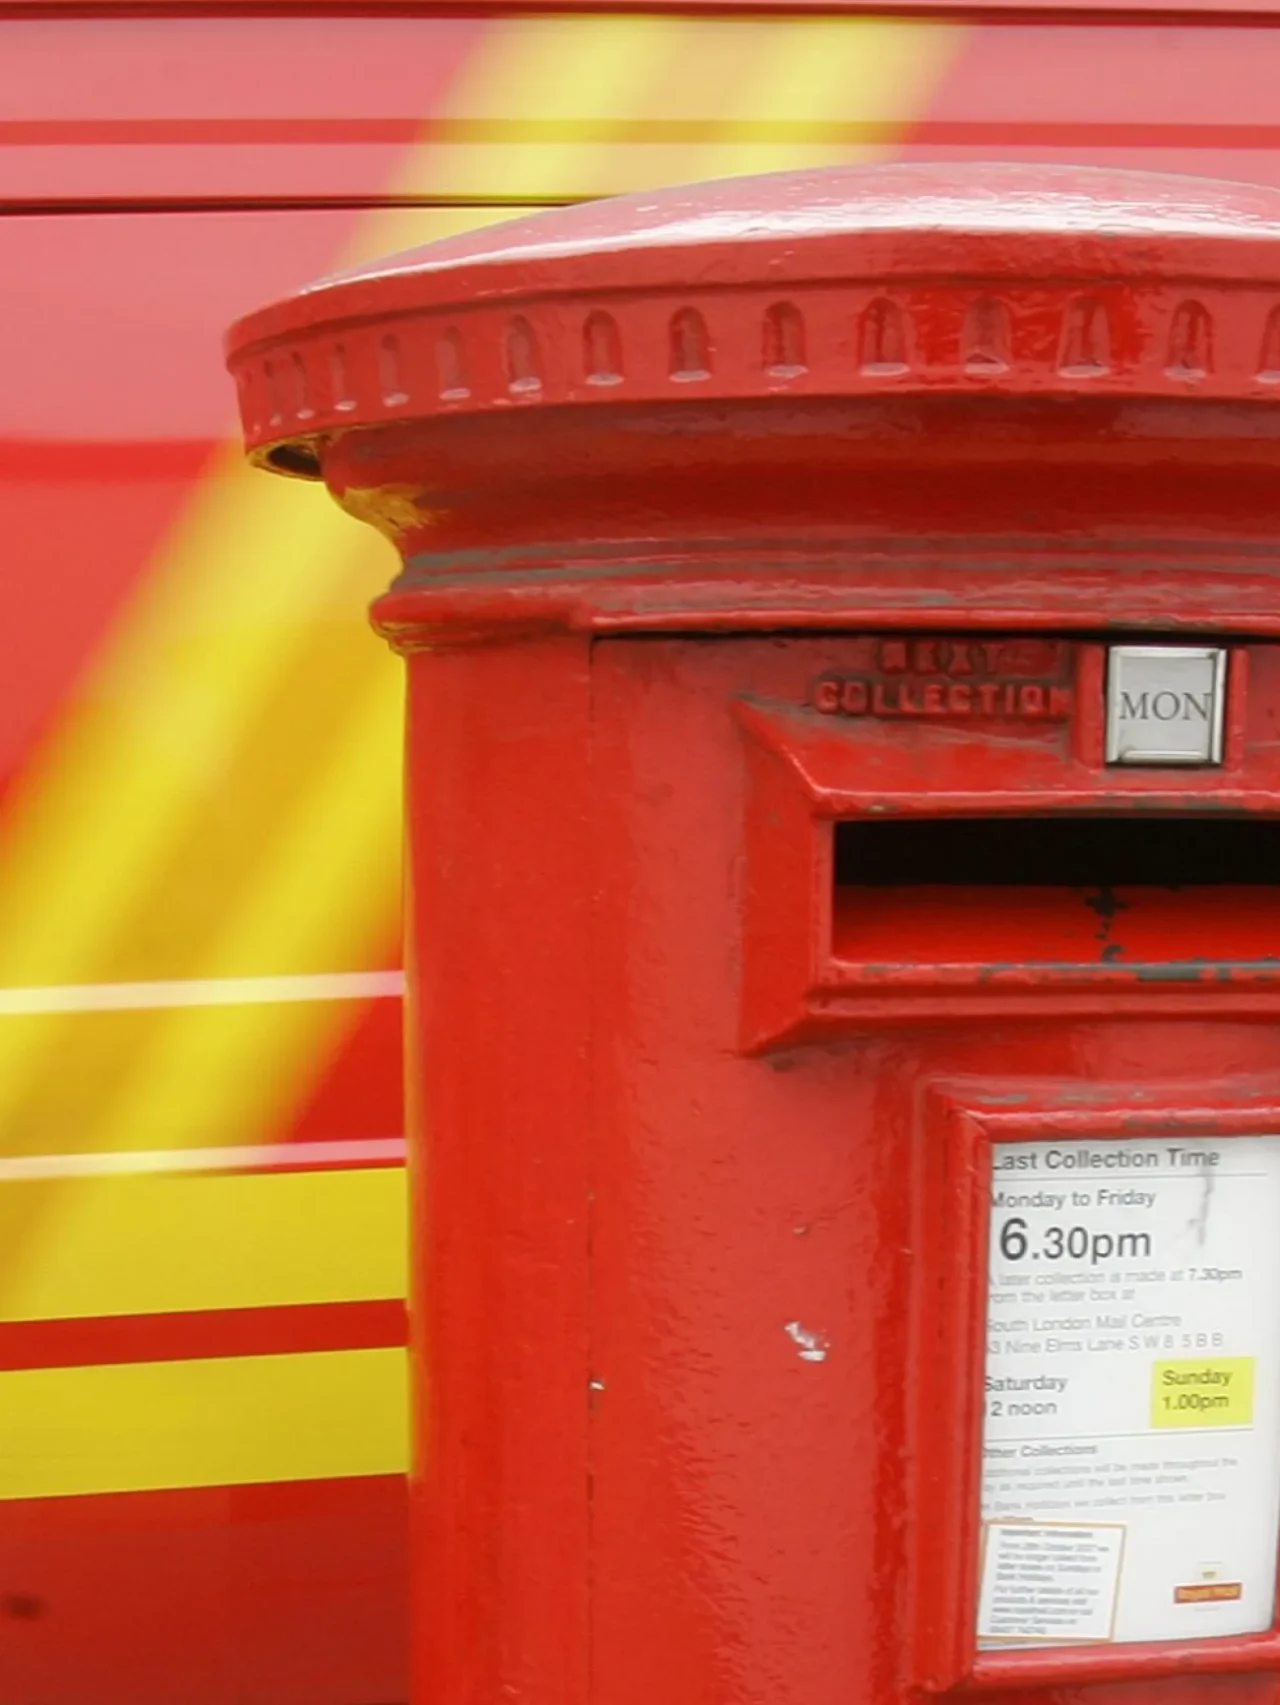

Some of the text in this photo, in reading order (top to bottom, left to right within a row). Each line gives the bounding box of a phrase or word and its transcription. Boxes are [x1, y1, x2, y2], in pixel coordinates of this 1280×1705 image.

[814, 679, 1074, 718] COLLECTION
[1118, 691, 1213, 721] MON
[1045, 1149, 1159, 1170] Collection
[1166, 1148, 1220, 1167] Time
[1071, 1191, 1091, 1208] to
[1097, 1188, 1156, 1209] Friday
[1001, 1217, 1152, 1265] 6.30pm
[1188, 1267, 1243, 1284] 7.30pm
[1033, 1316, 1092, 1331] London
[1096, 1315, 1127, 1329] Mail
[1005, 1339, 1041, 1354] Nine
[1087, 1337, 1125, 1351] Lane
[985, 1375, 1068, 1393] Saturday
[1162, 1368, 1232, 1387] Sunday
[1007, 1401, 1057, 1417] noon
[1162, 1393, 1230, 1413] 1.00pm
